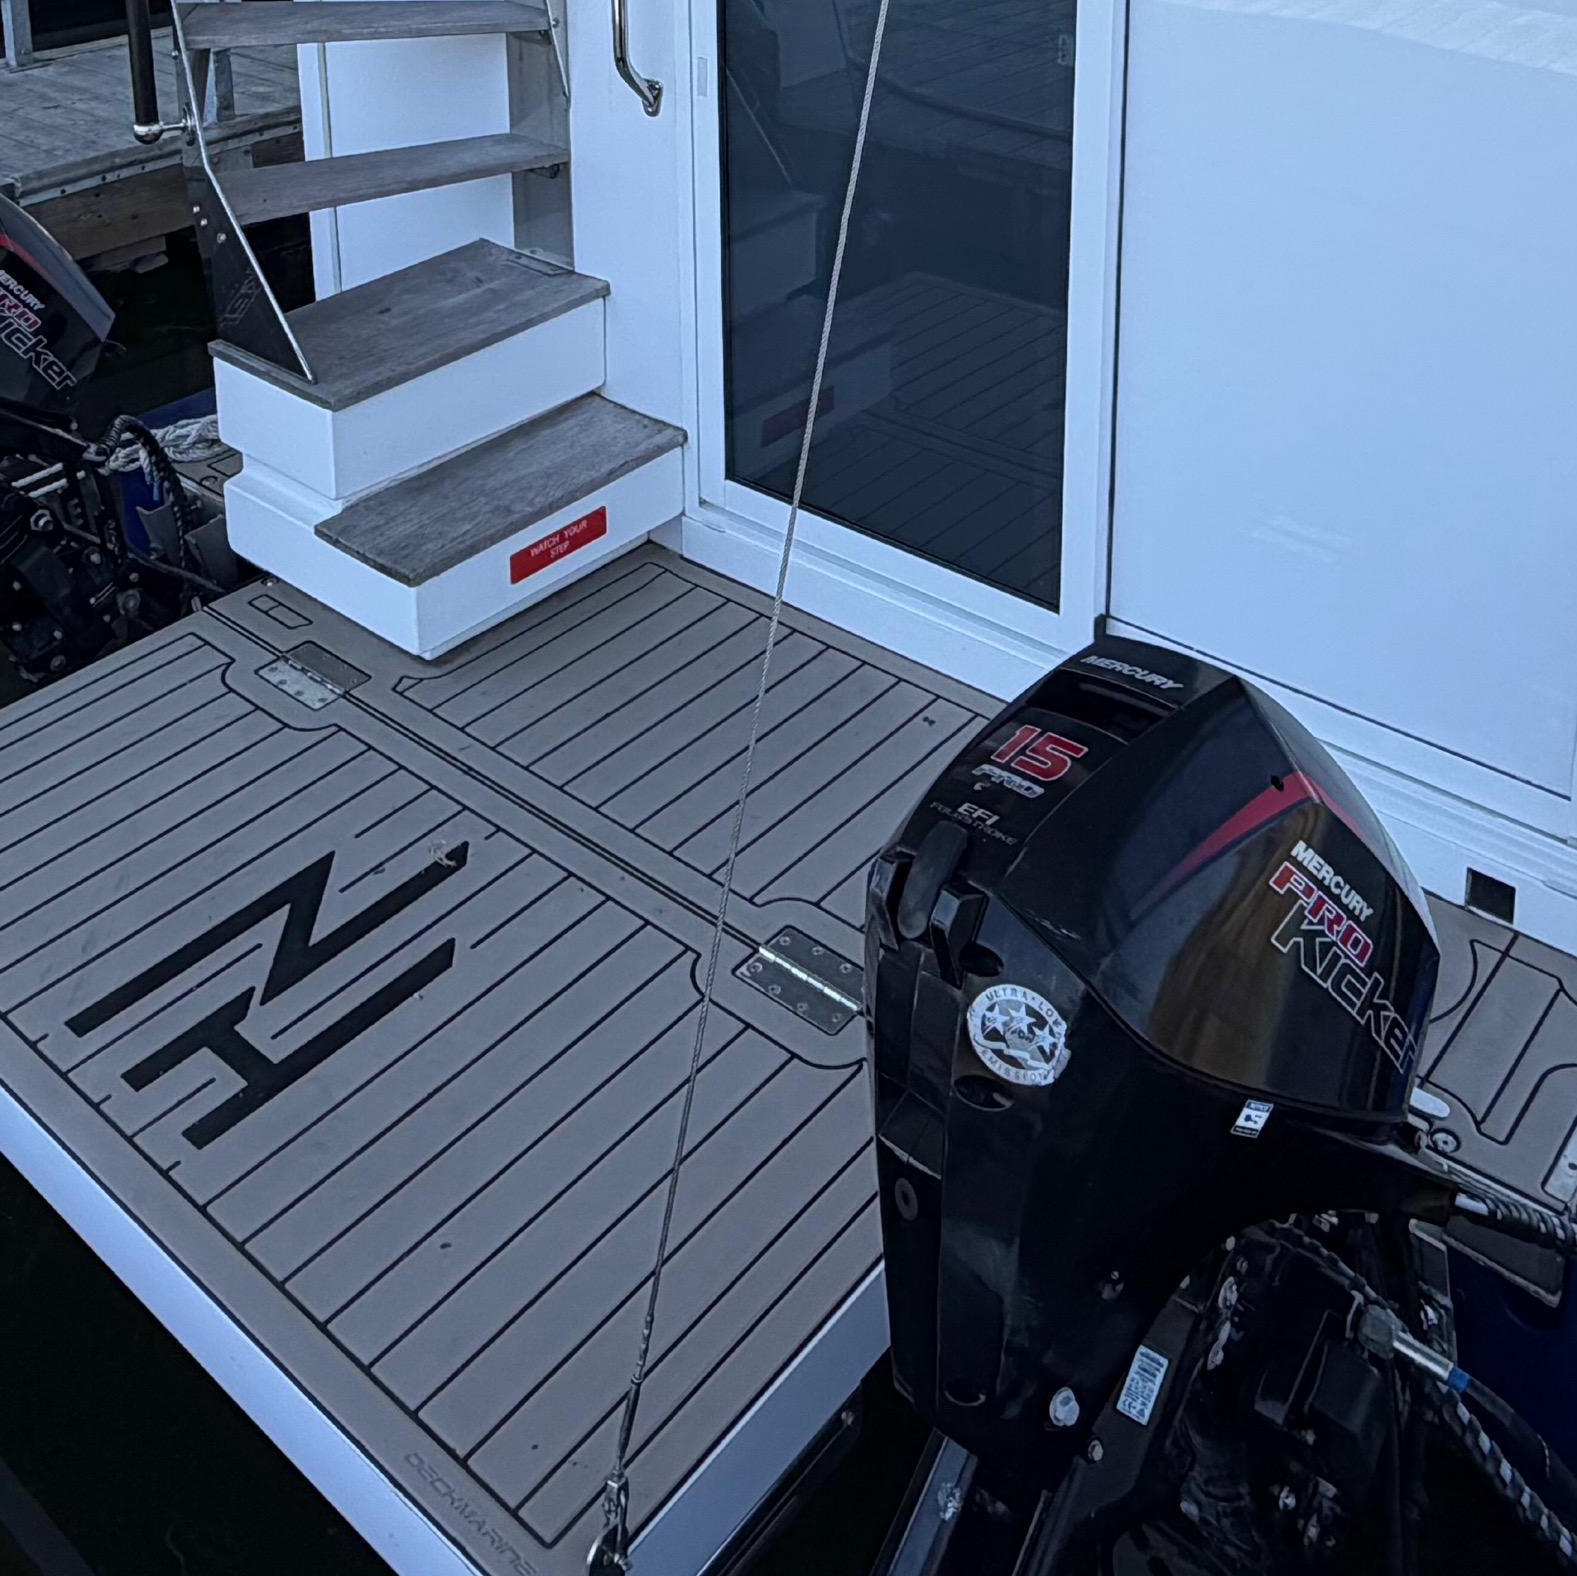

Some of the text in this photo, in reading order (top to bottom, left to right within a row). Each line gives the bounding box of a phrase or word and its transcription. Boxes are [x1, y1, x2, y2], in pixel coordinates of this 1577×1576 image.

[530, 519, 588, 558] WATCH YOUR
[550, 540, 570, 559] STEP
[1080, 655, 1185, 691] MERCURY
[990, 724, 1089, 782] 15
[971, 763, 1046, 800] PRO
[957, 802, 1001, 826] EFI
[1290, 840, 1375, 923] MERCURY
[1269, 861, 1374, 968] PRO
